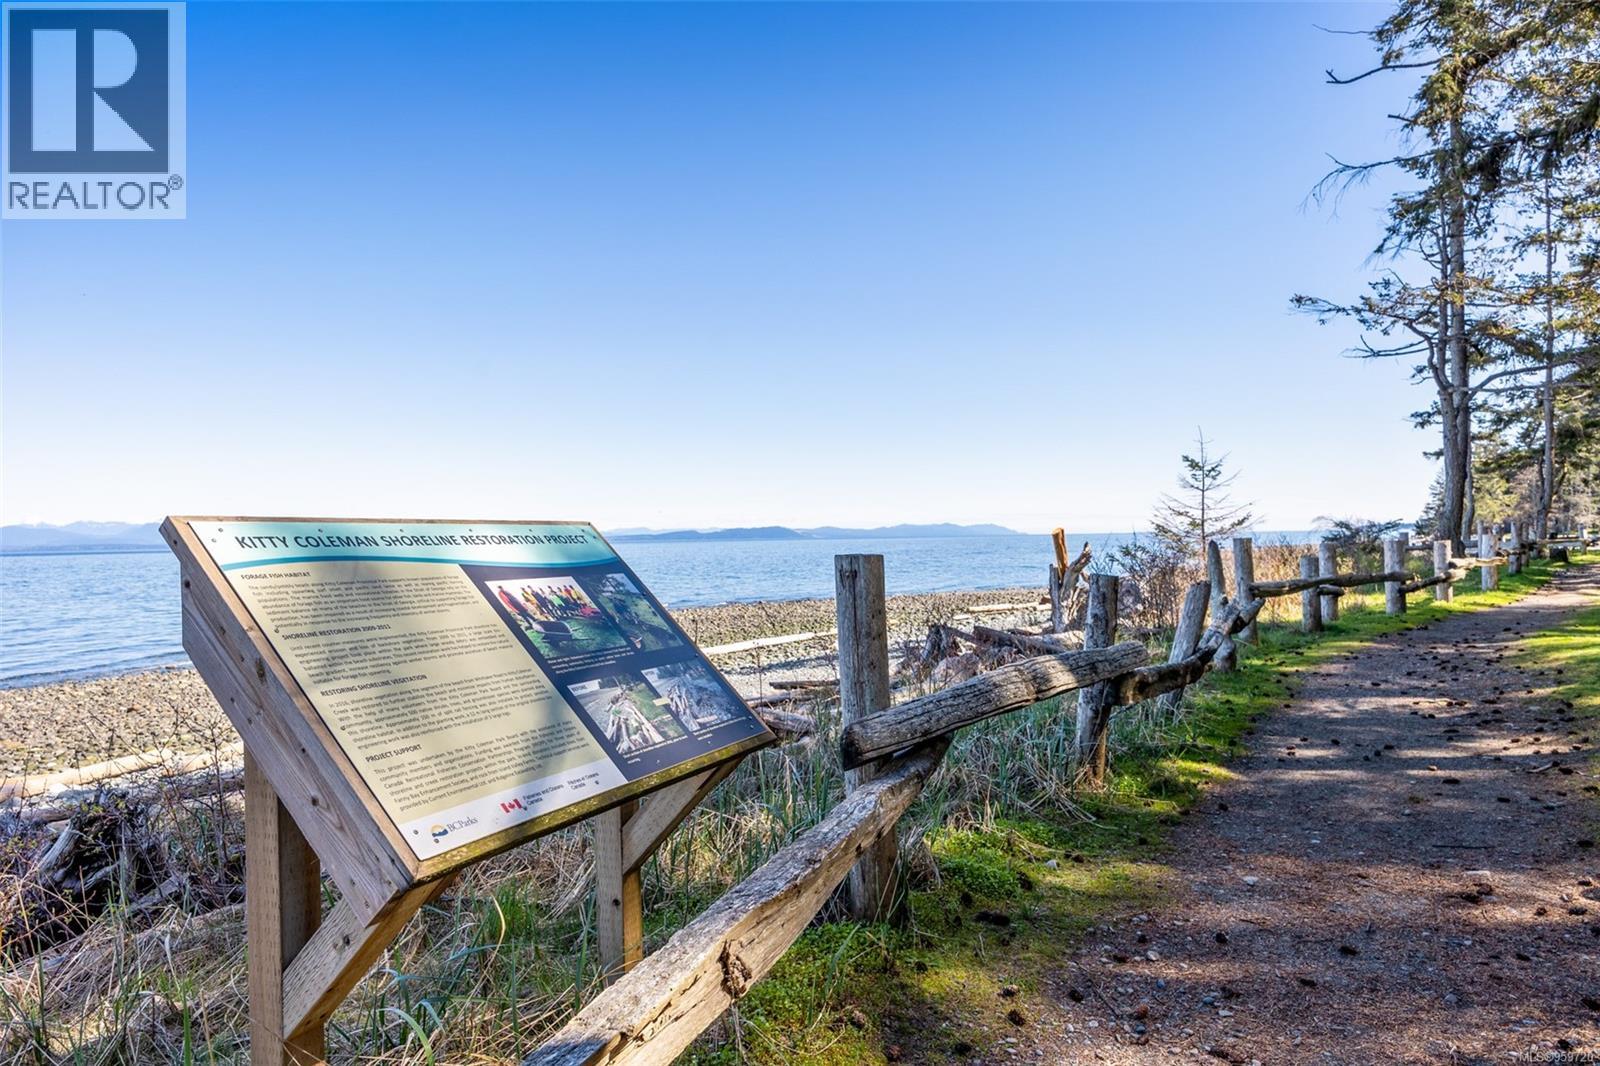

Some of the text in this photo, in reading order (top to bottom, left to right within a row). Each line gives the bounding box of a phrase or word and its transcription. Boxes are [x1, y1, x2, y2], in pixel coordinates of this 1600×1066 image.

[234, 533, 590, 549] KITTY COLEMAN SHORELINE RESTORATION PROJECT
[281, 631, 318, 639] SHORELINE
[318, 627, 361, 635] RESTORATION
[319, 674, 427, 696] RESTORING SHORELINE VEGETATION
[364, 744, 422, 762] PROJECT SUPPORT
[522, 791, 541, 799] Fisheries
[548, 783, 564, 791] Oceans
[526, 797, 543, 805] Canada
